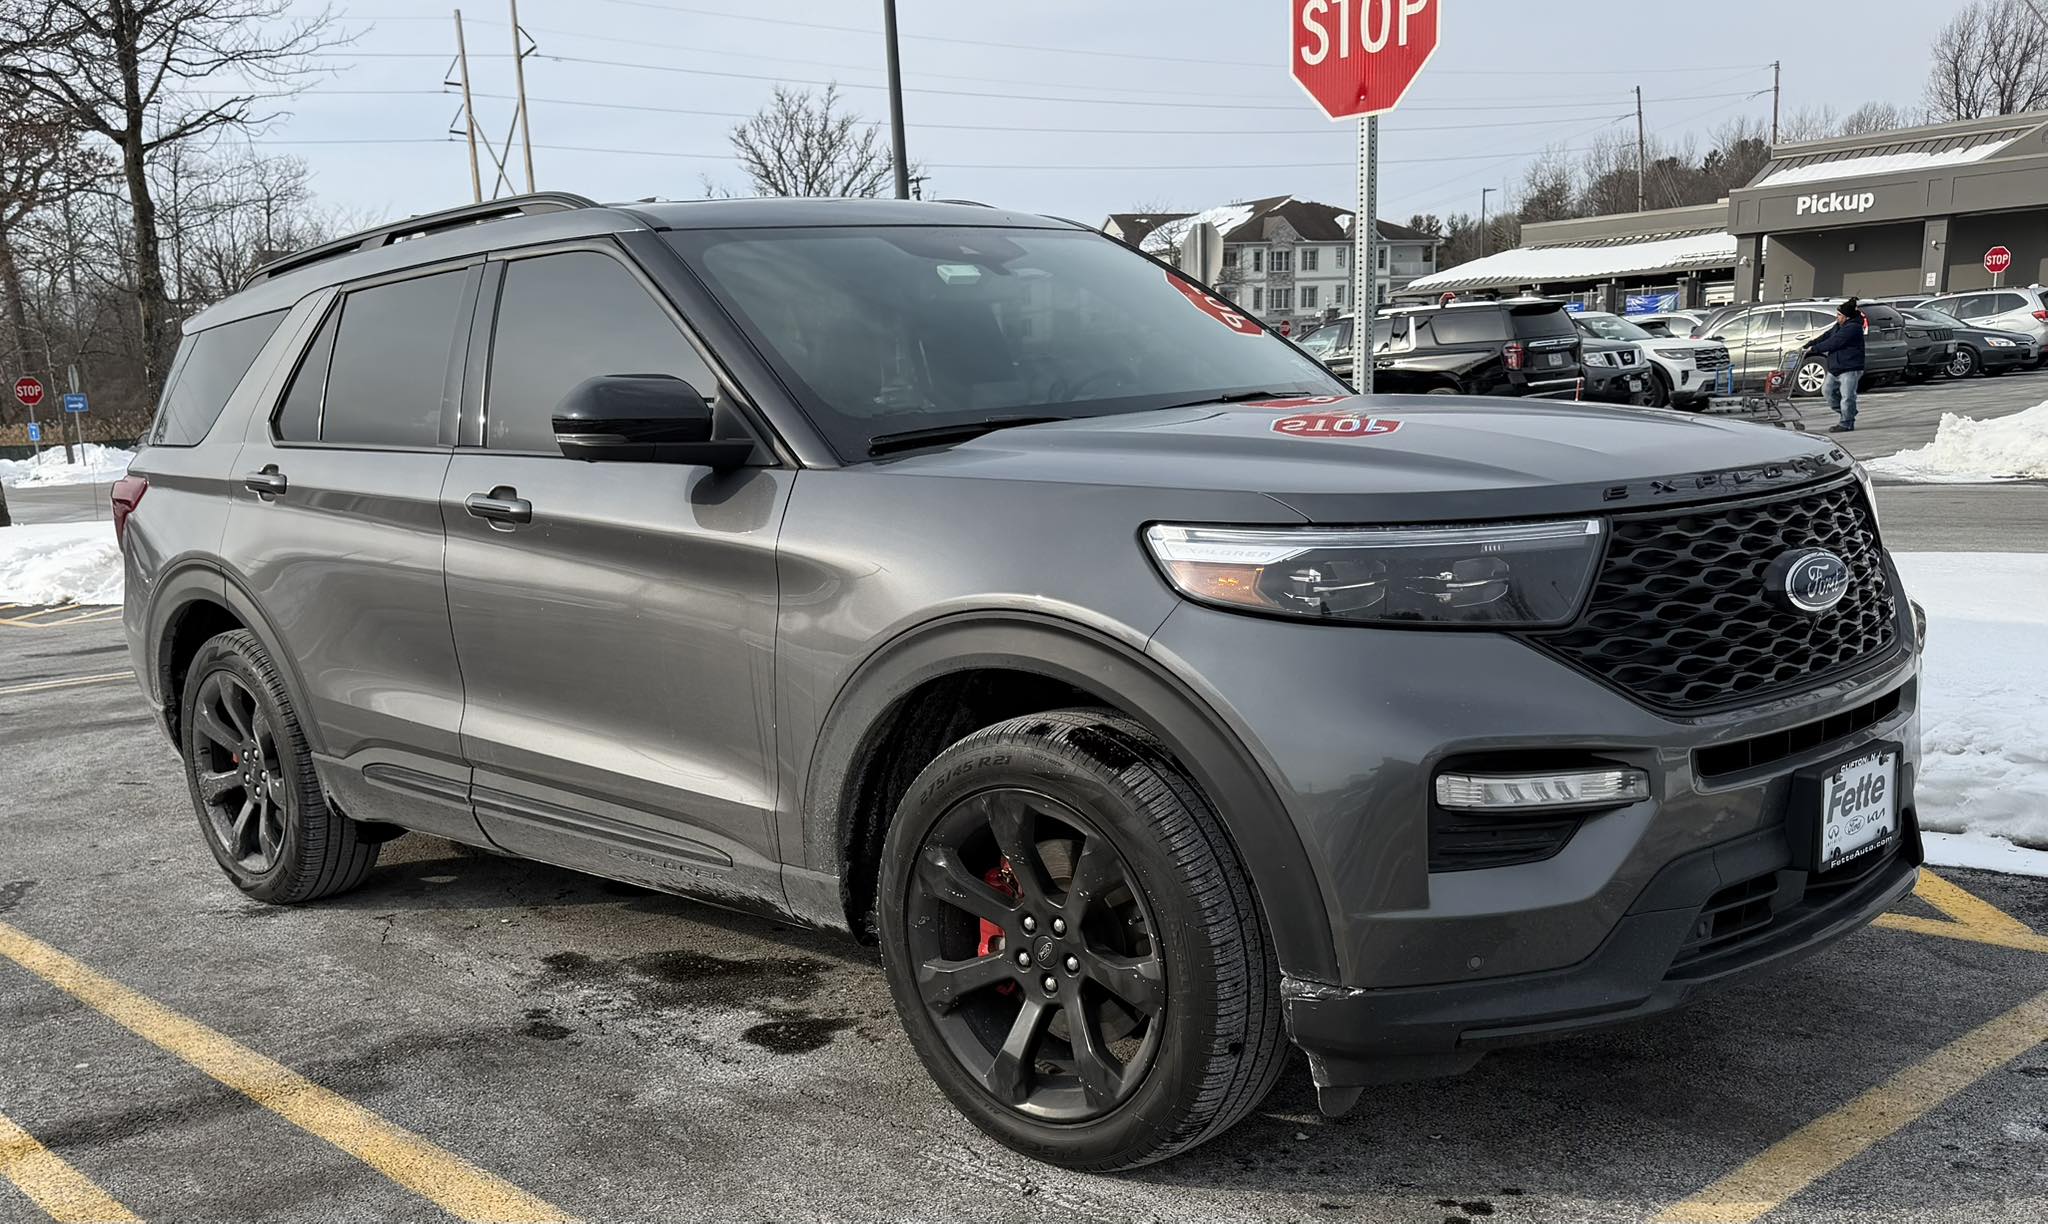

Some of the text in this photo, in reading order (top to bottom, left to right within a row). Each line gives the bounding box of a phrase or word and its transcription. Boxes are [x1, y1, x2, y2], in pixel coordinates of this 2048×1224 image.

[1301, 0, 1428, 65] STOP
[1796, 192, 1875, 215] Pickup
[1986, 254, 2009, 266] STOP
[16, 385, 41, 397] STOP
[1602, 449, 1845, 501] EXPLORER
[977, 755, 1013, 769] R21
[1827, 773, 1885, 824] Fette
[1831, 836, 1893, 869] FetteAuto.com
